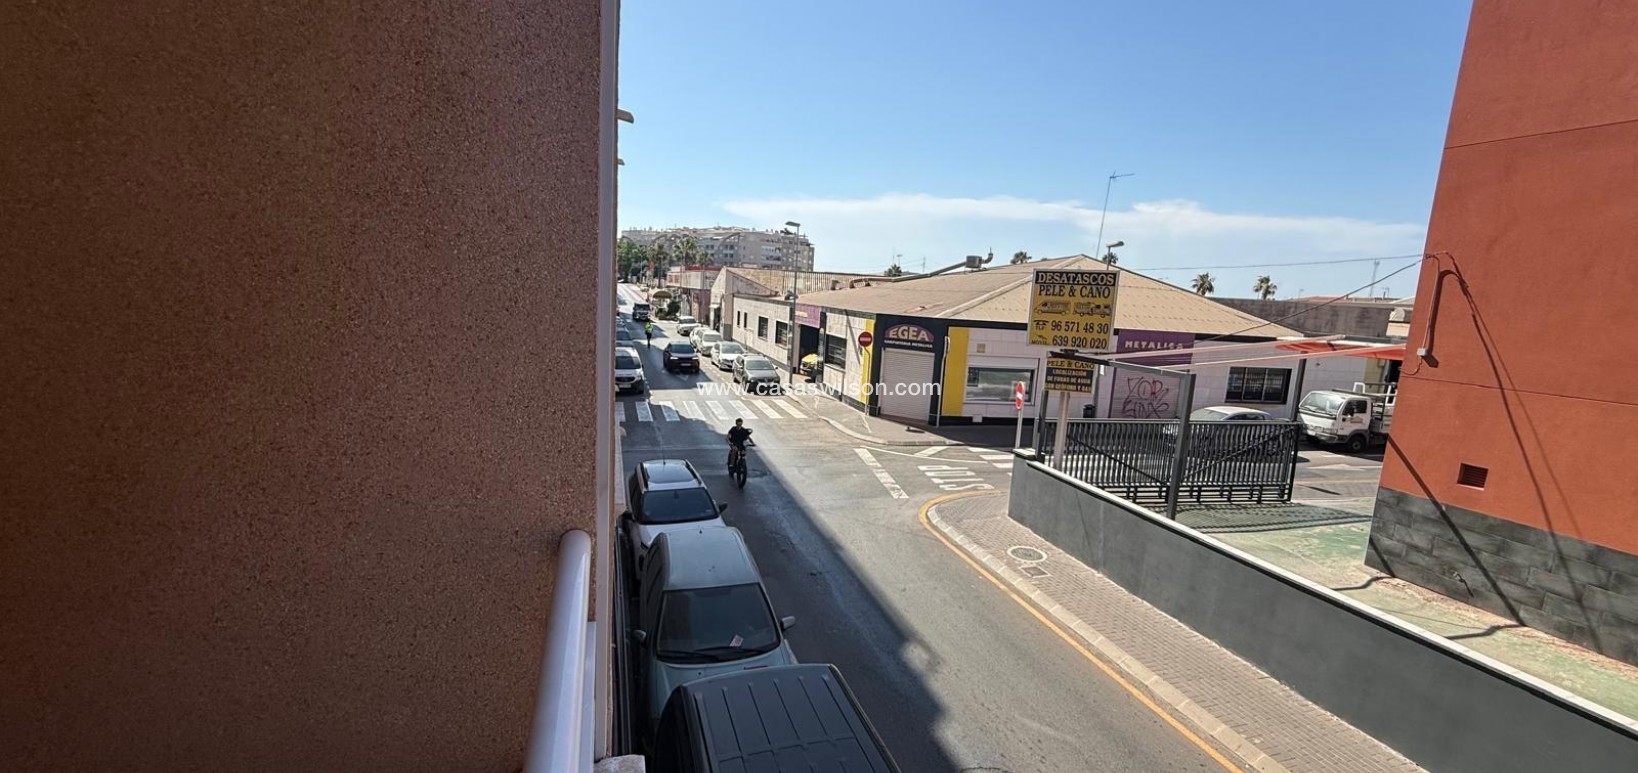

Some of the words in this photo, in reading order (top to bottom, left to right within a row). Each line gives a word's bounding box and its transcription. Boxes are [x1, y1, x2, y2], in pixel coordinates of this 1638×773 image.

[1038, 273, 1114, 284] DESATASCOS
[1038, 285, 1065, 296] PELE
[1068, 285, 1076, 298] &
[1080, 285, 1111, 299] CANO
[889, 326, 929, 341] EGEA
[1051, 320, 1062, 331] 96
[1064, 321, 1080, 333] 571
[1083, 322, 1094, 334] 48
[1096, 323, 1109, 335] 30
[1052, 335, 1069, 347] 639
[1070, 336, 1087, 348] 920
[1089, 337, 1107, 350] 020
[1125, 340, 1184, 350] METALICA
[1075, 361, 1095, 369] CANO
[917, 464, 995, 491] STOP
